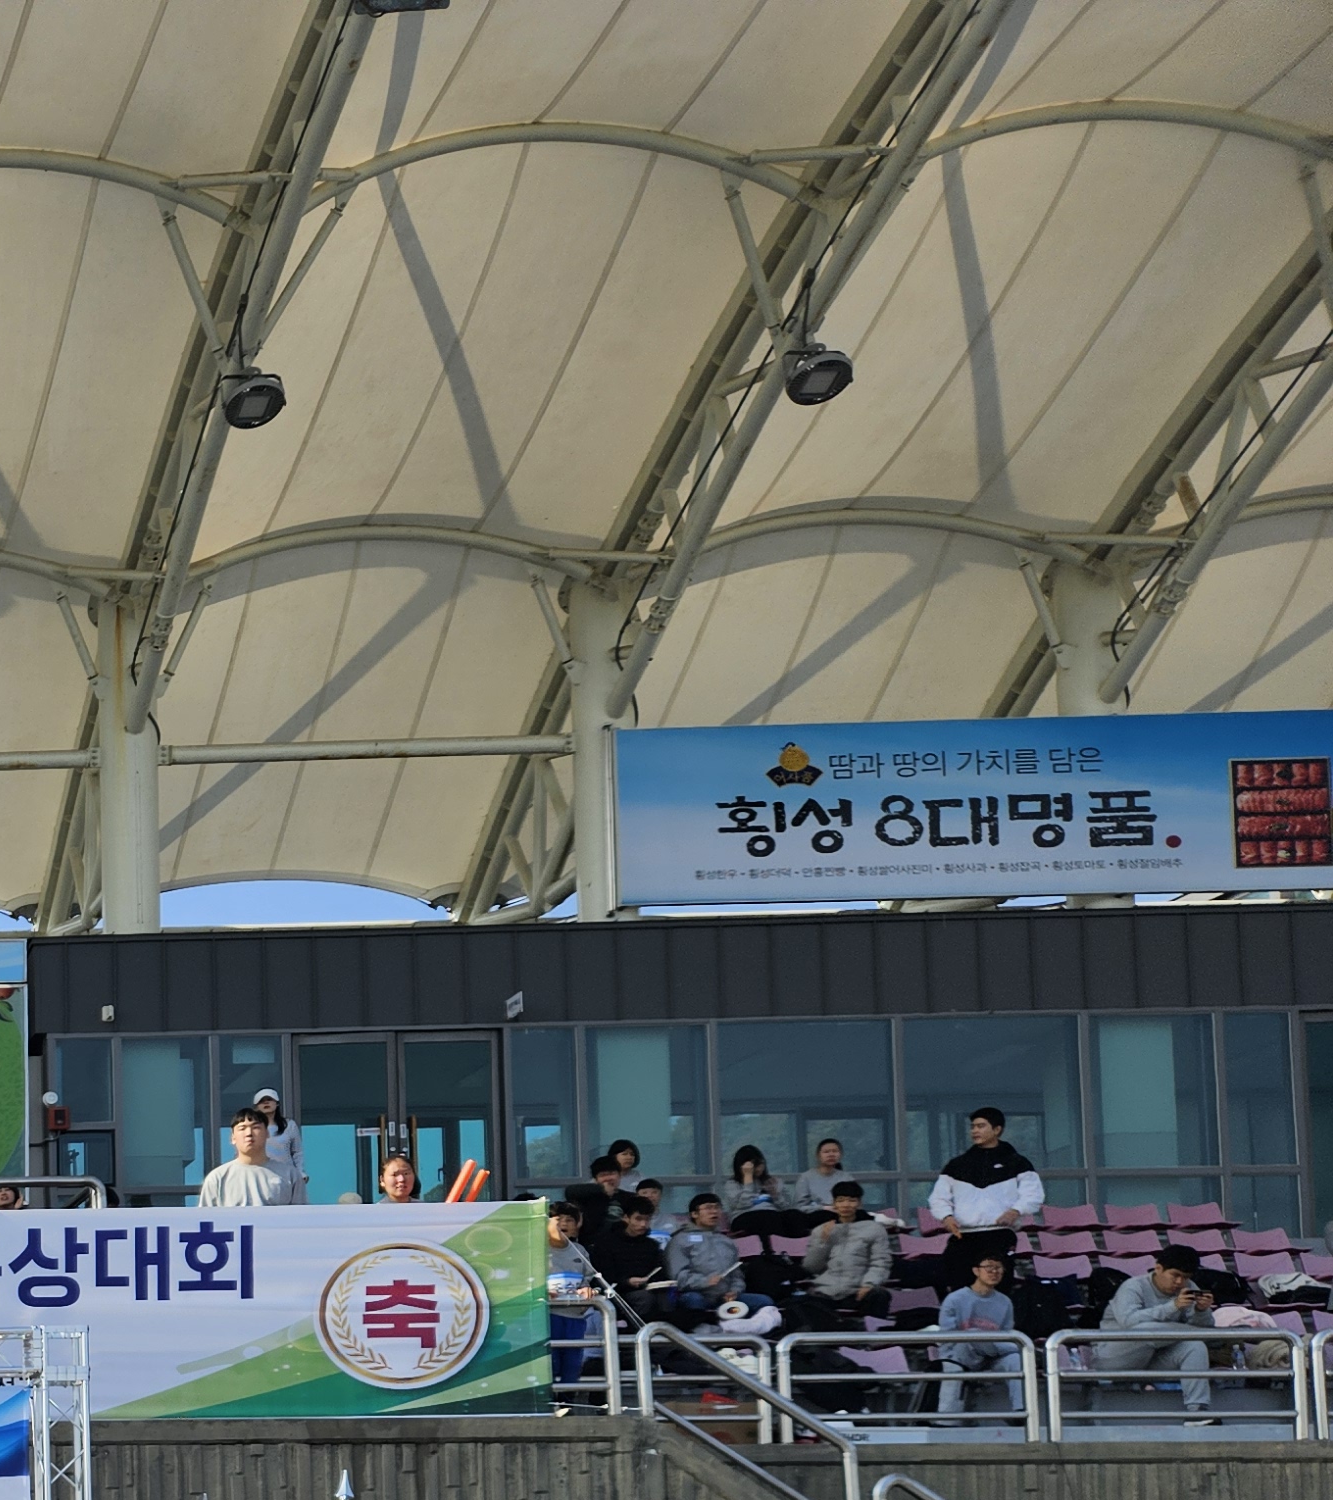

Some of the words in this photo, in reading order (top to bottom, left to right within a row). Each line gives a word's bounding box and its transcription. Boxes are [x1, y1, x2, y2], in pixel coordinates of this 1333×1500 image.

[829, 751, 885, 780] 땀과
[892, 750, 946, 778] 땅의
[962, 748, 1040, 776] 가치를
[1049, 745, 1104, 775] 담은
[715, 795, 852, 858] 횡성
[362, 1279, 441, 1350] 축
